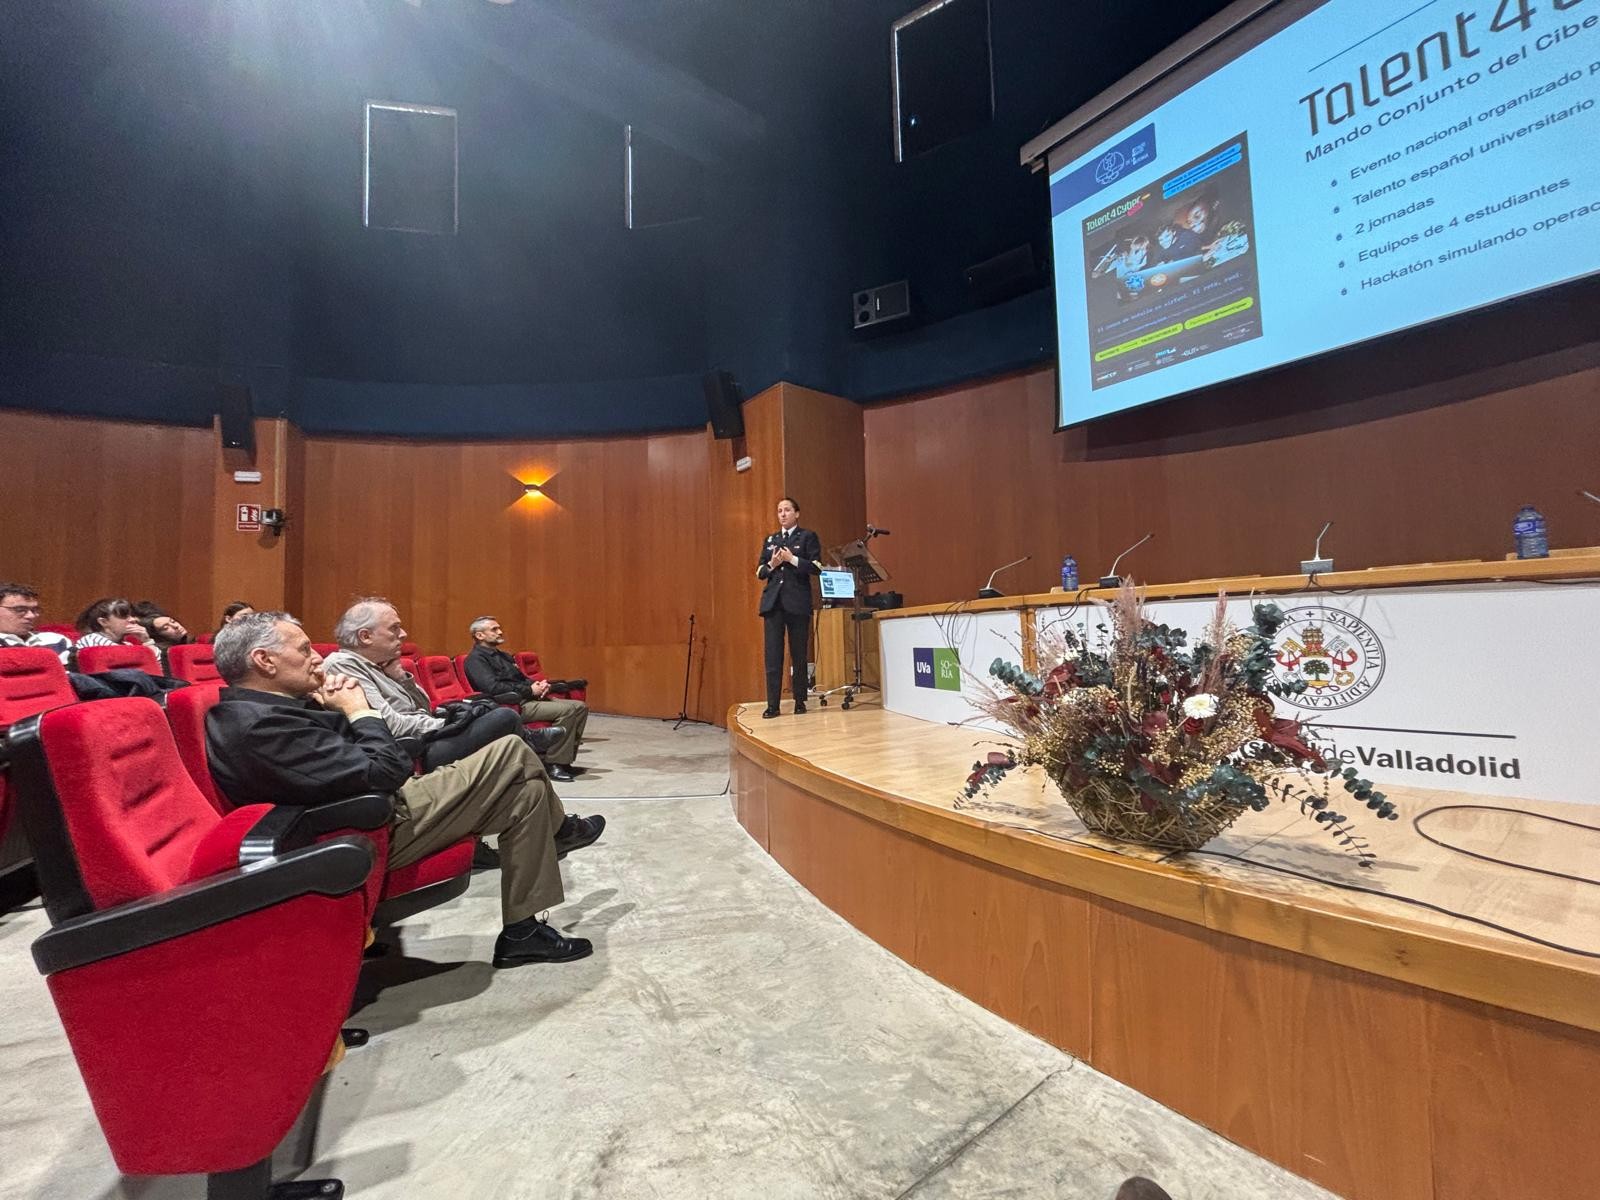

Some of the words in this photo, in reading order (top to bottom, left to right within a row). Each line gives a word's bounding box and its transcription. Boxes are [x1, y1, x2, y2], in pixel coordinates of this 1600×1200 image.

[1305, 123, 1373, 163] Mando
[1378, 71, 1481, 127] Conjunto
[1488, 45, 1528, 74] del
[1536, 15, 1600, 51] Cibe
[1350, 152, 1402, 180] Evento
[1405, 116, 1473, 155] nacional
[1478, 70, 1583, 122] organizado
[1352, 178, 1407, 206] Talento
[1411, 149, 1474, 183] español
[1480, 99, 1595, 154] universitario
[1355, 222, 1365, 235] 2
[1368, 197, 1436, 232] jornadas
[1358, 233, 1420, 263] Equipos
[1424, 223, 1444, 238] de
[1449, 216, 1459, 228] 4
[1464, 178, 1571, 223] estudiantes
[1361, 259, 1433, 290] Hackatón
[1438, 226, 1527, 264] simulando
[916, 661, 931, 674] UVa
[1328, 612, 1381, 670] SAPIENTIA
[942, 670, 953, 679] RIA
